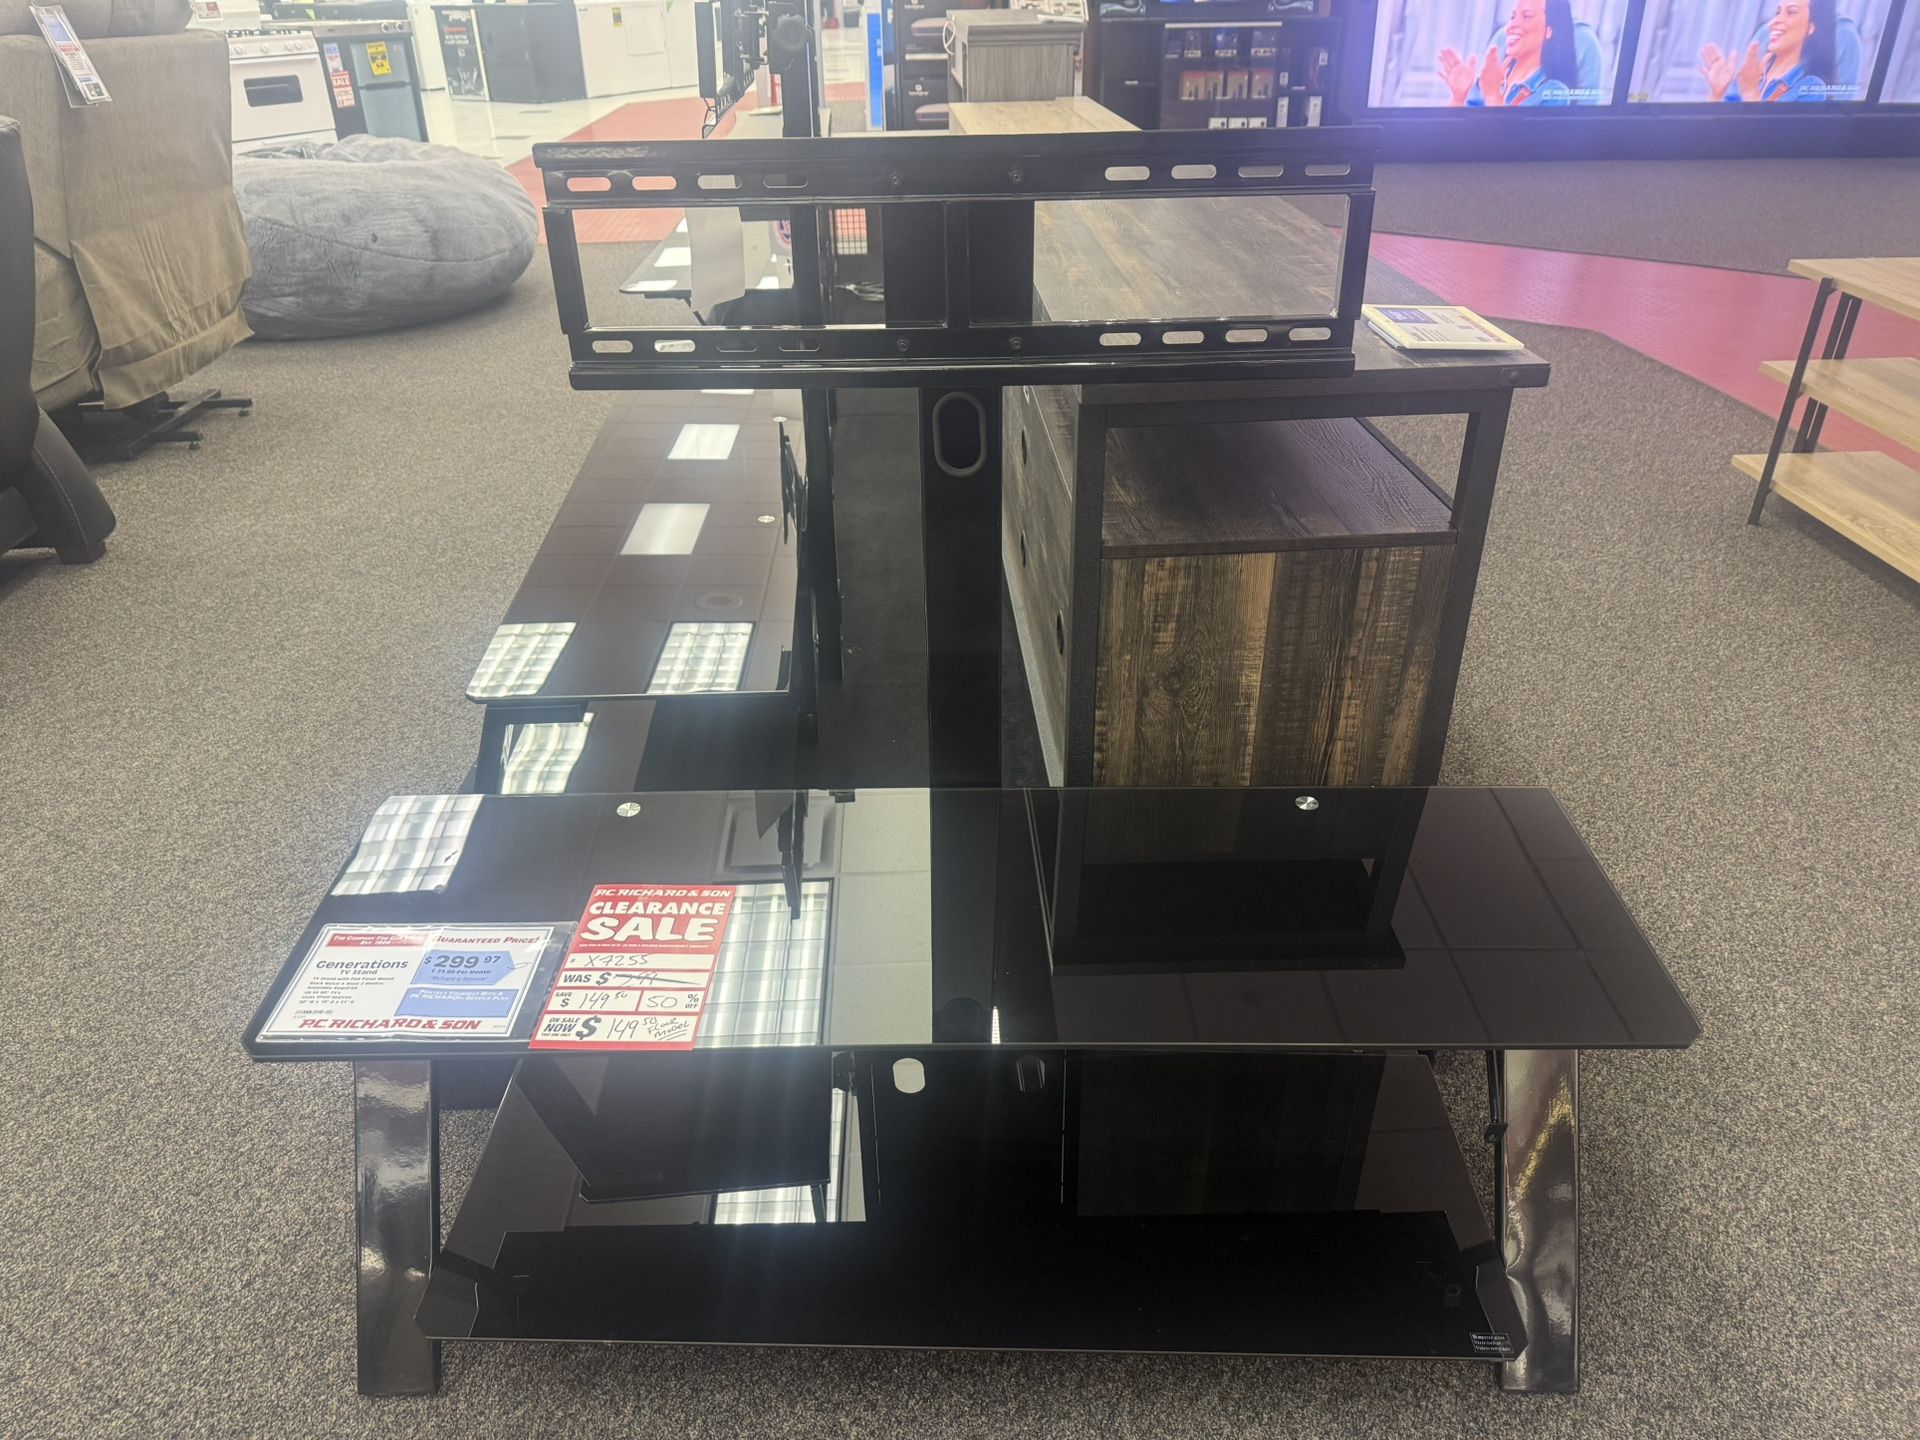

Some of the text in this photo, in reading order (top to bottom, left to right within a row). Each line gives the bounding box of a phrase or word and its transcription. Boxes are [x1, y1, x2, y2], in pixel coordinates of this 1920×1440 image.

[687, 889, 699, 897] &
[589, 902, 726, 915] CLEARANCE
[580, 916, 718, 942] SALE
[316, 960, 408, 970] Generations
[434, 955, 480, 968] 299
[564, 974, 592, 983] WAS
[596, 972, 611, 985] $
[560, 998, 570, 1008] $
[579, 992, 610, 1009] 149
[647, 994, 699, 1008] 50 %
[328, 1018, 422, 1028] RICHARD
[421, 1020, 437, 1028] &
[439, 1020, 481, 1029] SON
[544, 1024, 576, 1032] NOW
[576, 1015, 602, 1040] $
[606, 1018, 639, 1040] 149
